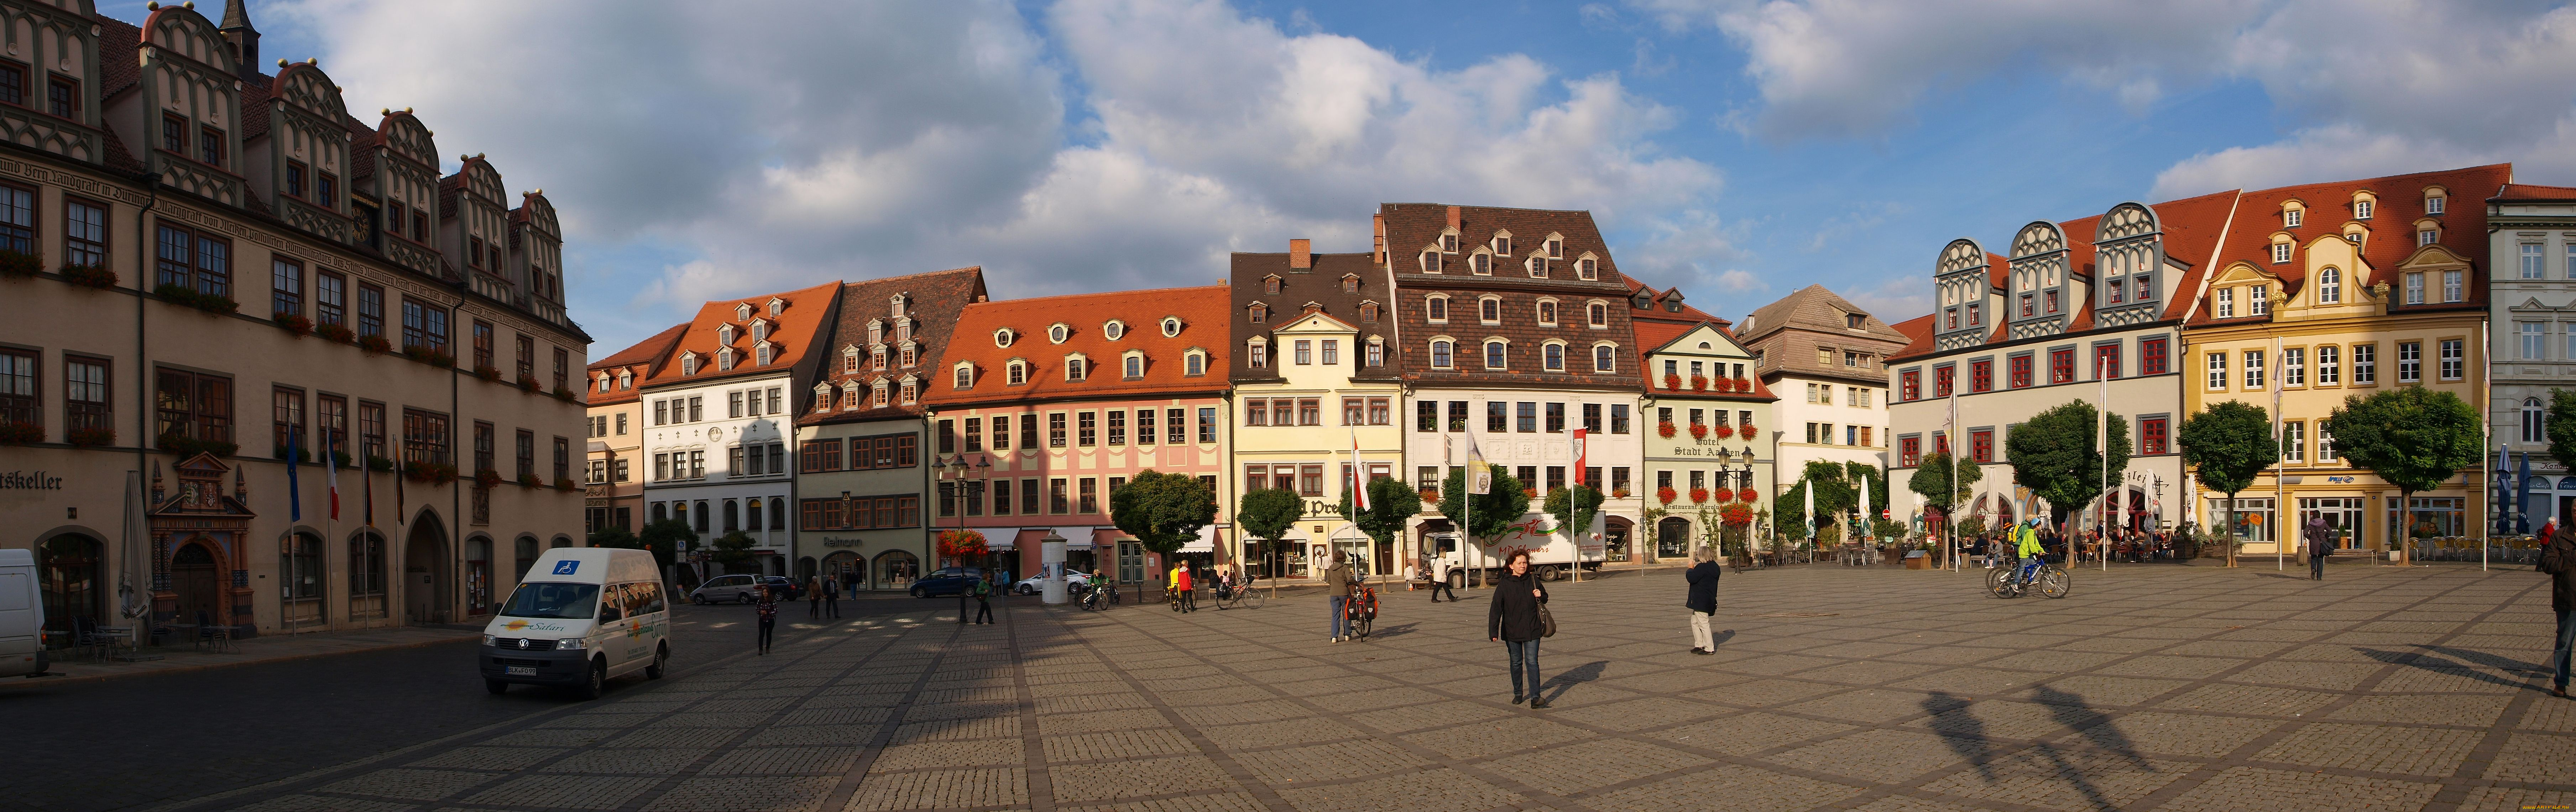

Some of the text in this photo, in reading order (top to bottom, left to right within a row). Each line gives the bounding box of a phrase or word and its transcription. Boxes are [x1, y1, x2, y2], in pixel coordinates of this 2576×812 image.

[103, 183, 110, 196] in
[204, 215, 218, 228] von
[1674, 446, 1700, 456] Stadt
[824, 536, 862, 547] Fielmann
